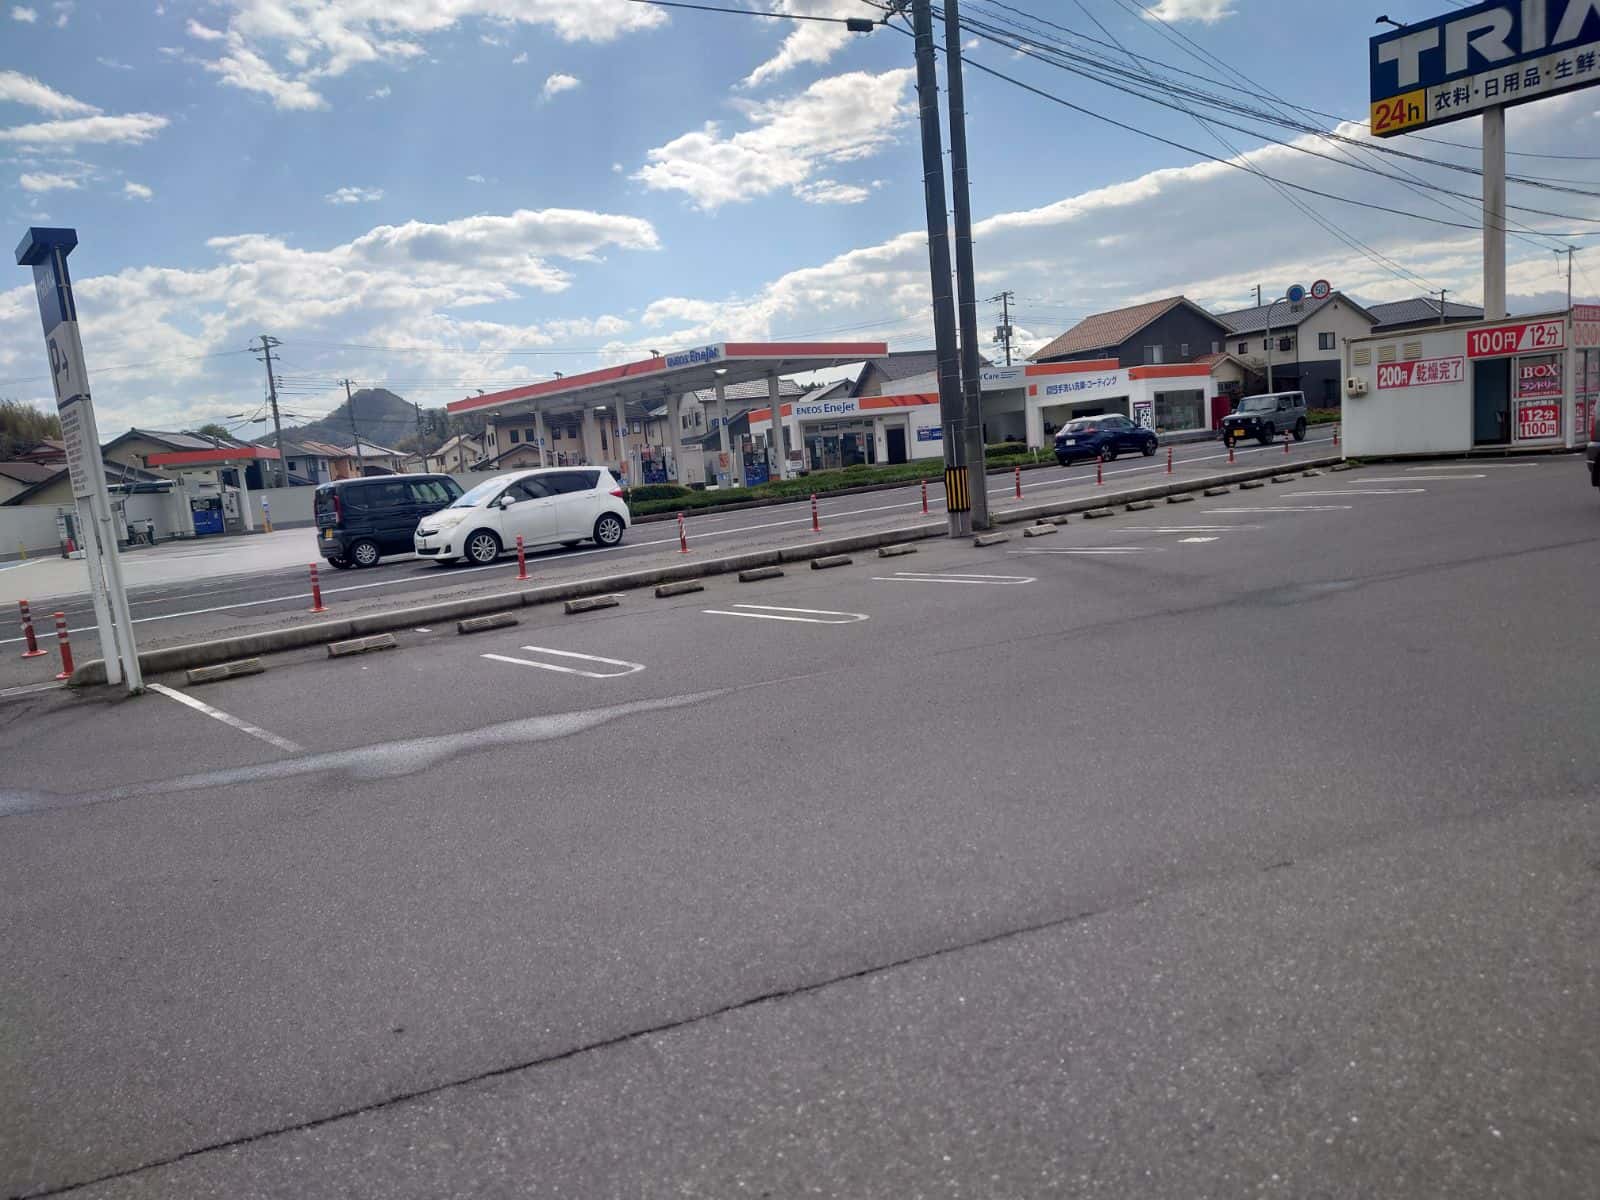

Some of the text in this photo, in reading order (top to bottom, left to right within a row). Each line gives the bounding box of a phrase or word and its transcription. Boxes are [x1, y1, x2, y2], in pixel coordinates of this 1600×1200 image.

[1434, 50, 1600, 111] 衣料・日用品・生鮮
[1375, 99, 1420, 130] 24h
[1472, 331, 1517, 353] 100円
[1530, 325, 1559, 347] 12分
[1380, 361, 1461, 387] 200円 乾燥完了
[796, 406, 823, 415] ENEOS
